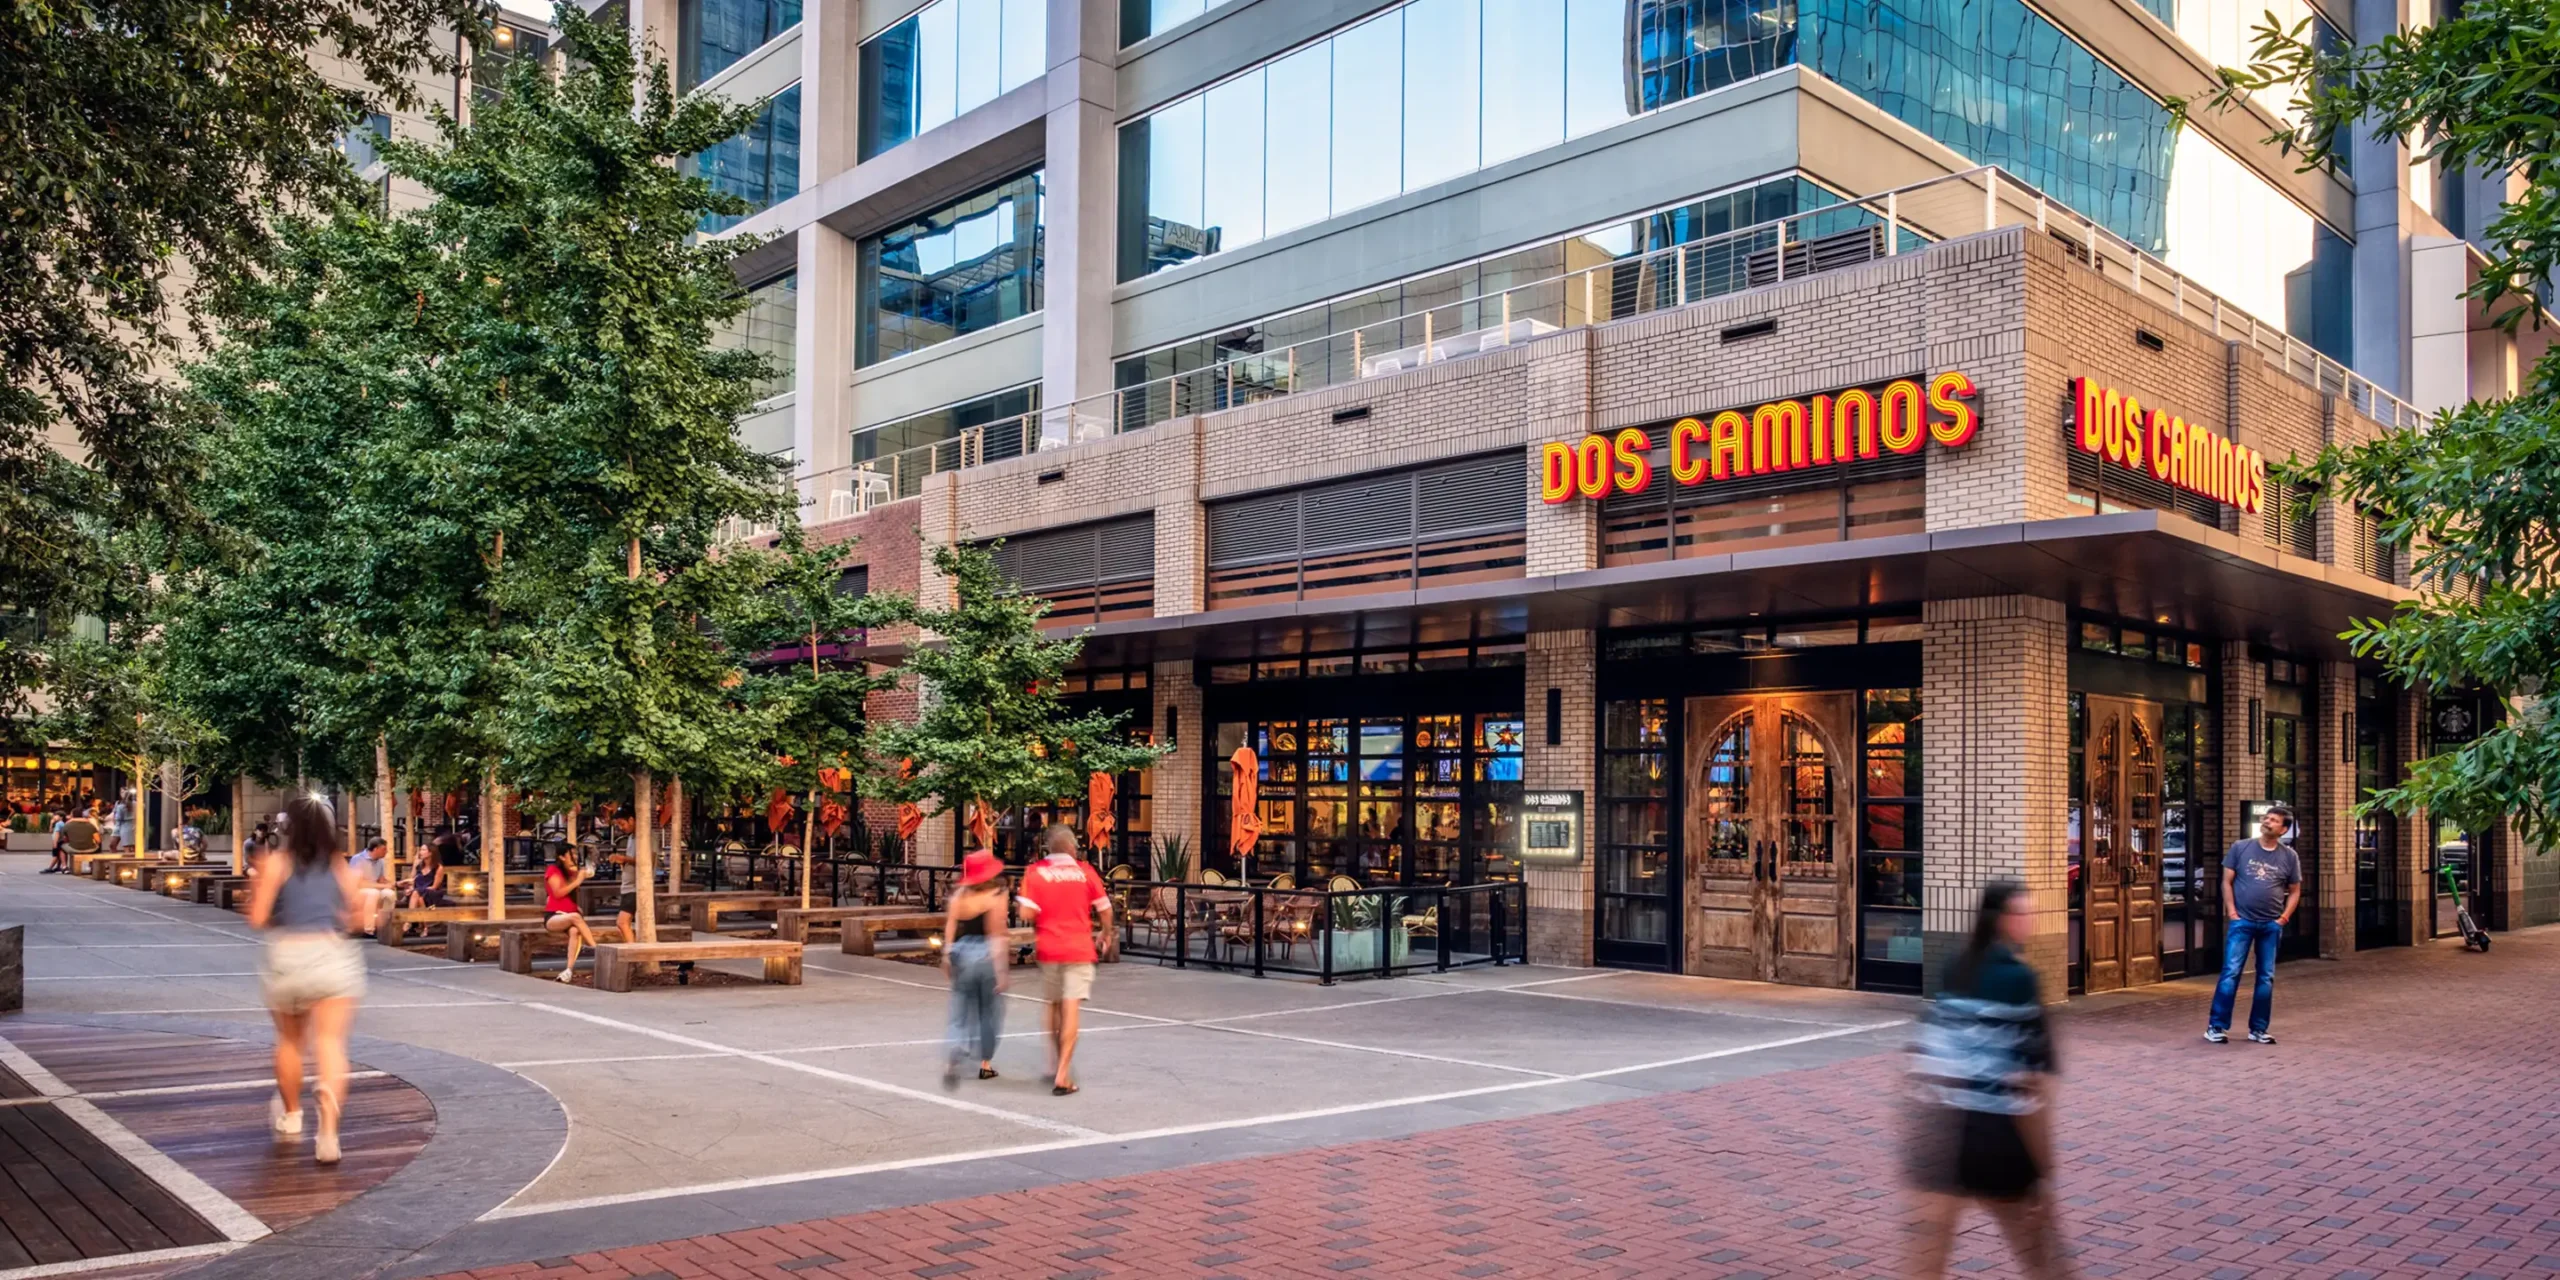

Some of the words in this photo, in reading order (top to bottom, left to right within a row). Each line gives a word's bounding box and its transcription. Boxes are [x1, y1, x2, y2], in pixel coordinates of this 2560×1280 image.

[1542, 428, 1652, 505] DOS
[1671, 371, 1979, 486] CAMINOS
[2076, 376, 2143, 470] DOS
[2145, 407, 2265, 514] CAMINOS
